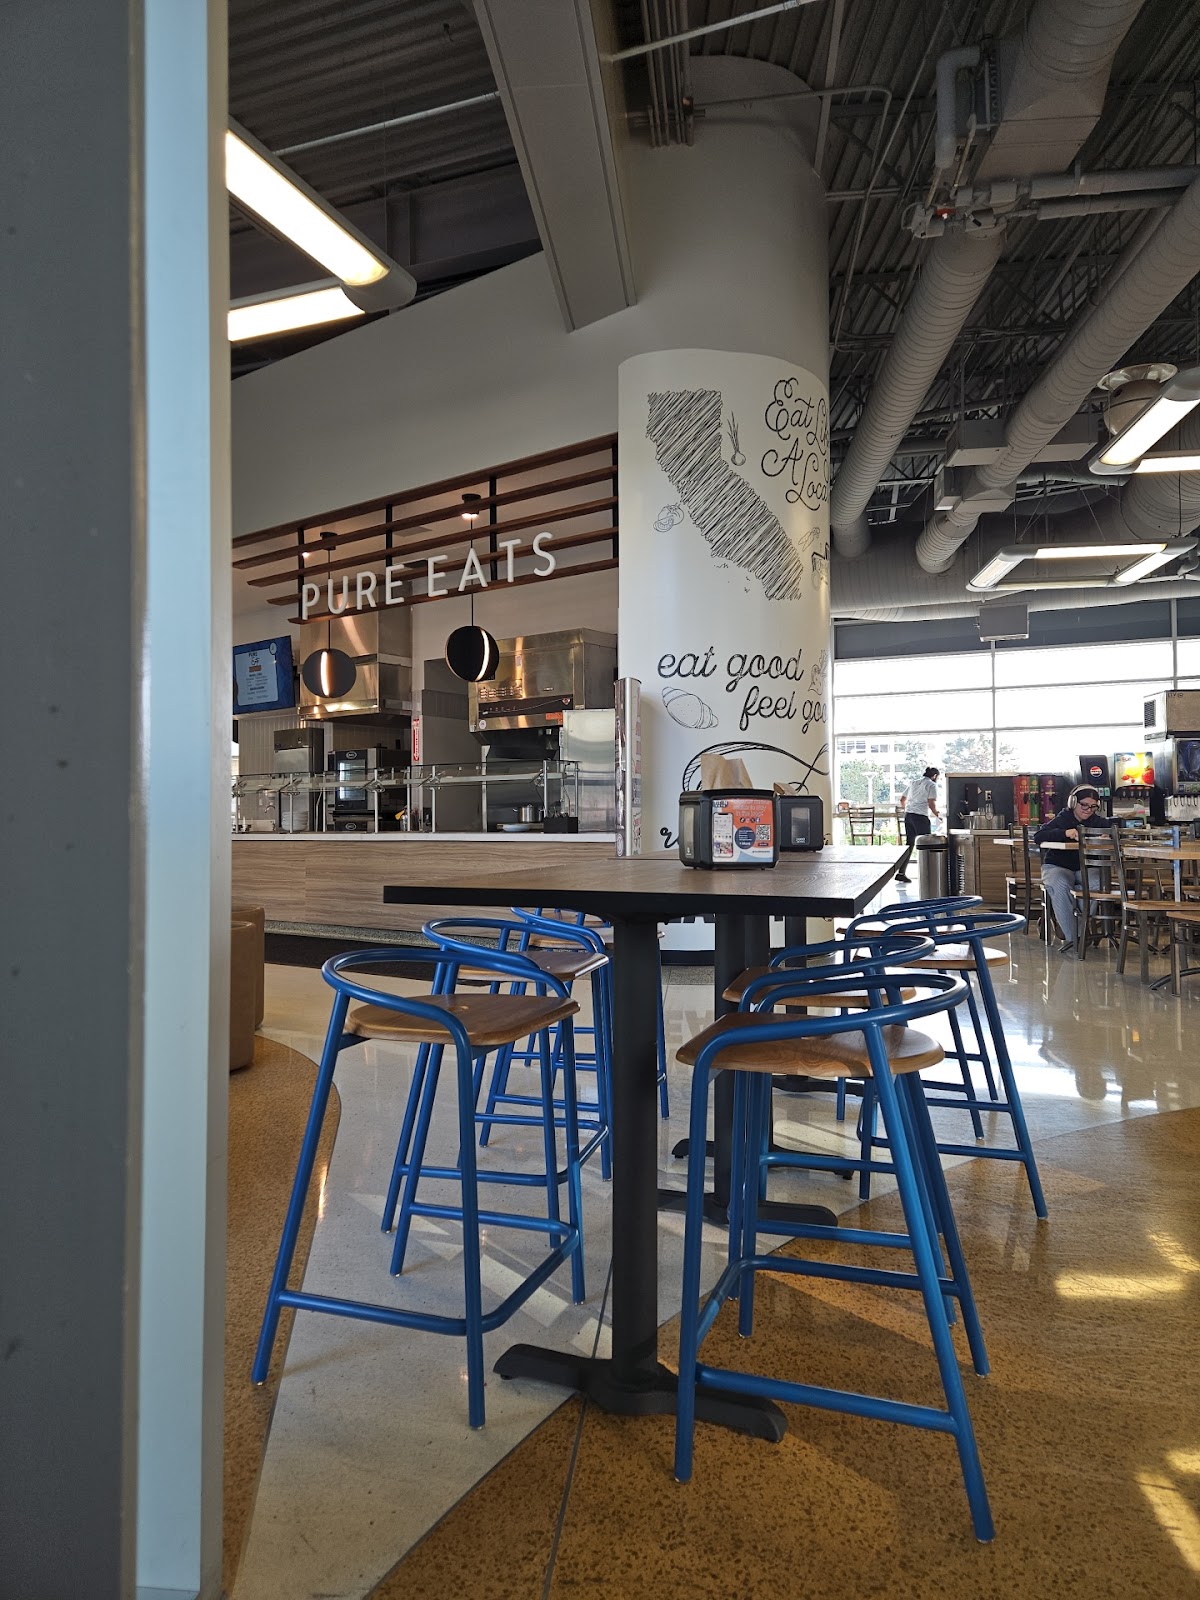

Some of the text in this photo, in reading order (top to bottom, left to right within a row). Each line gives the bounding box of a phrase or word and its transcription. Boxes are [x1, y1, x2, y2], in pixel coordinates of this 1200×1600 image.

[764, 377, 815, 441] Eat
[760, 437, 804, 486] A
[301, 531, 557, 621] PURE EATS
[656, 646, 805, 693] eat good
[738, 685, 829, 734] feel goo
